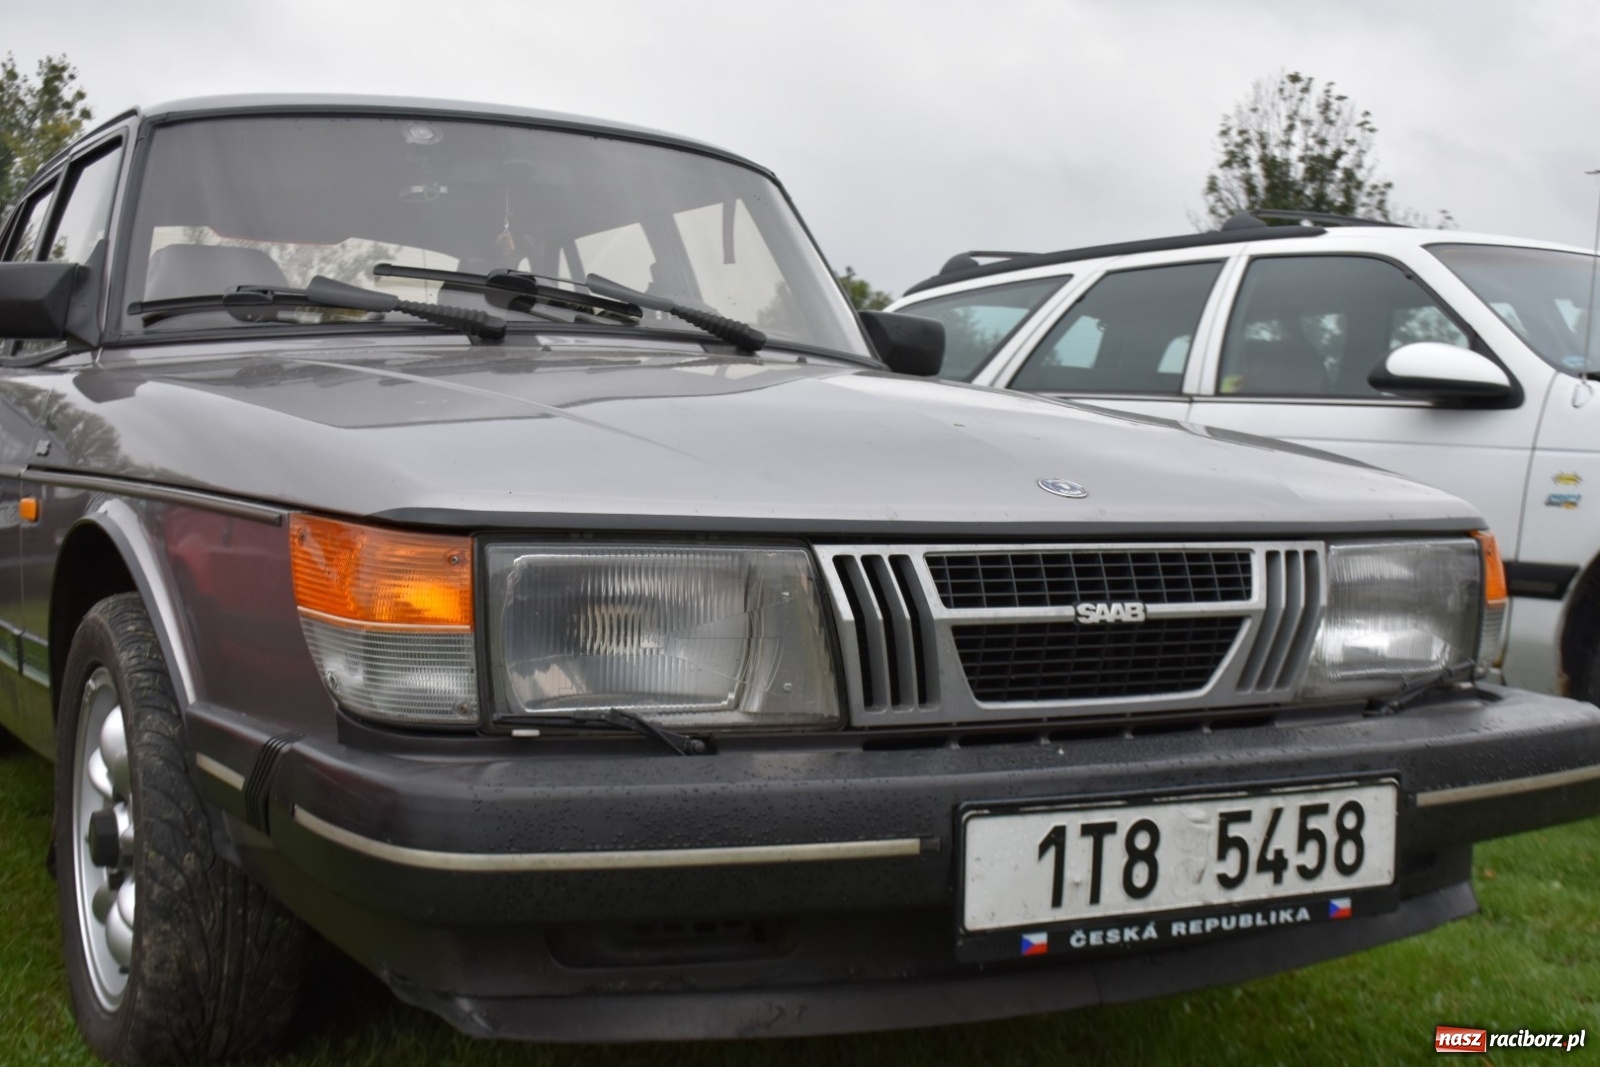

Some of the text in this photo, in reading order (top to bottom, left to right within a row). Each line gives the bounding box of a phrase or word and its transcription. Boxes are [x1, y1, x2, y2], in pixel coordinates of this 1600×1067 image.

[1077, 603, 1145, 624] SAAB
[1038, 800, 1365, 908] 1T8 5458
[1070, 906, 1311, 949] ČESKÁ REPUBLIKA
